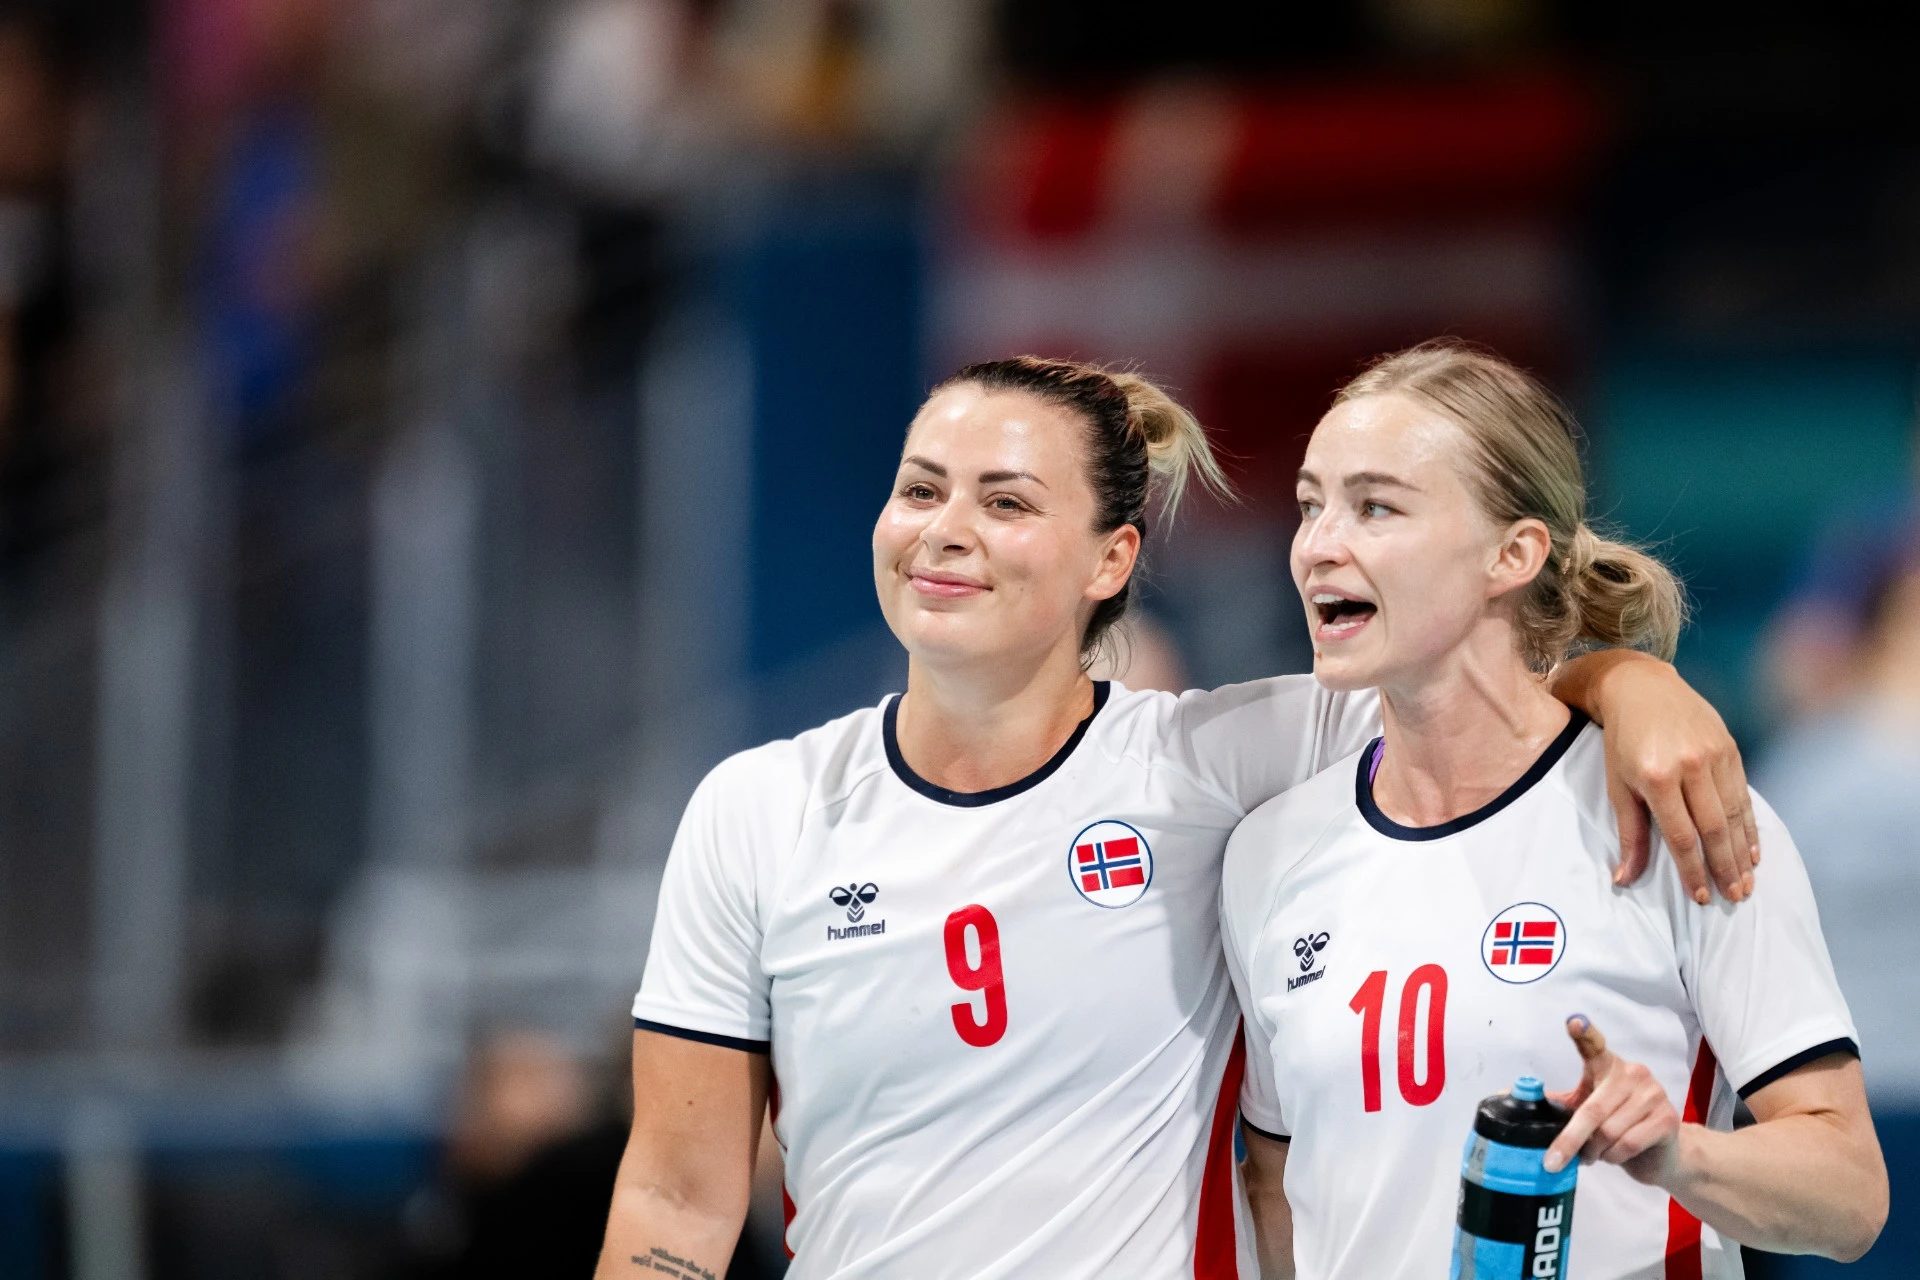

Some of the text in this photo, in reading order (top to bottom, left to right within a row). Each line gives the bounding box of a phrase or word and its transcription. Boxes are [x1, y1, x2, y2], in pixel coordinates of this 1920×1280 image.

[827, 919, 886, 941] hummel
[943, 903, 1009, 1047] 9
[1287, 964, 1326, 993] hummel
[1348, 963, 1448, 1113] 10
[1532, 1204, 1564, 1280] ADE
